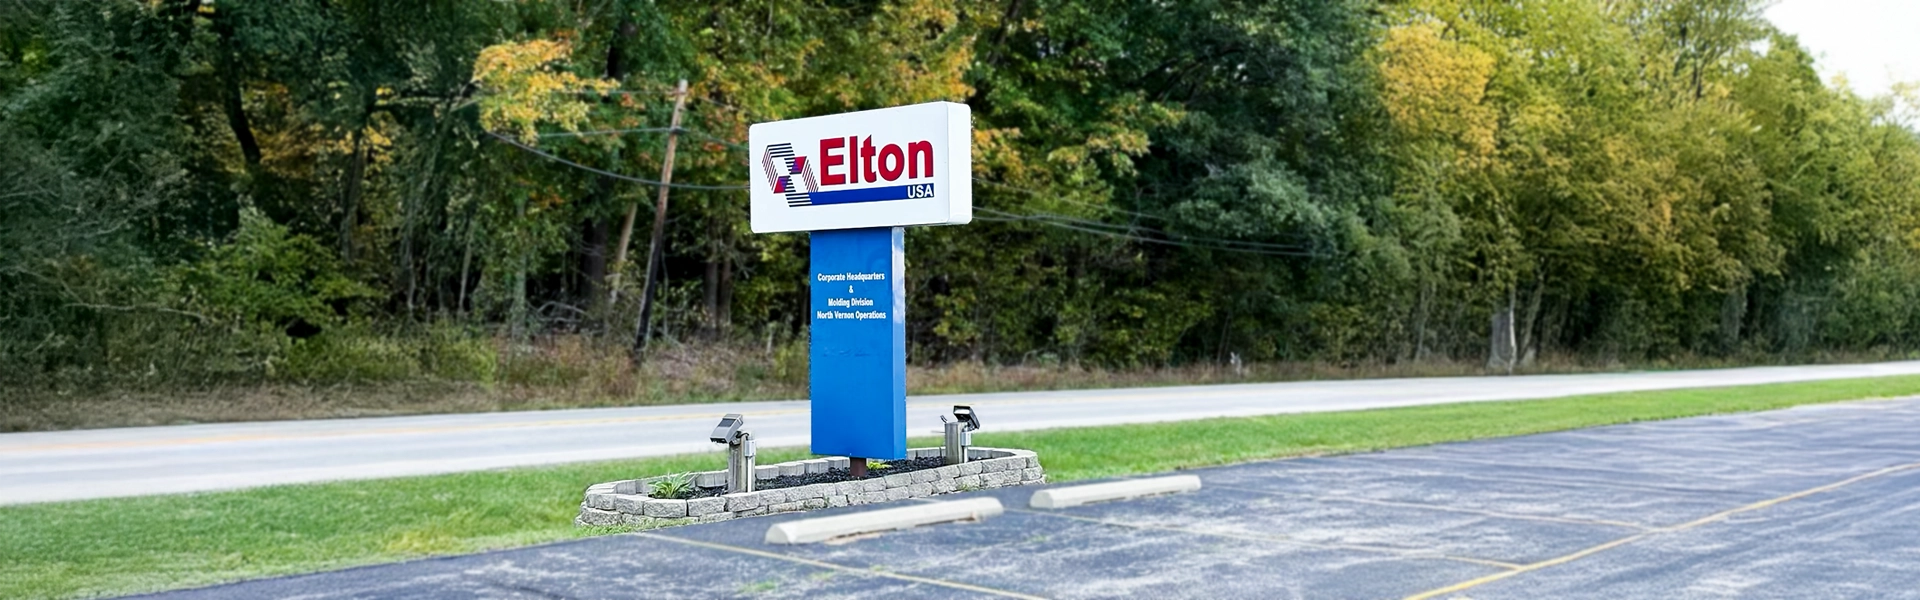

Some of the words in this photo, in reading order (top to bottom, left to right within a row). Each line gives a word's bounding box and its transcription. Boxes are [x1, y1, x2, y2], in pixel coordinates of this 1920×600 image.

[820, 134, 934, 186] Elton
[907, 185, 933, 198] USA
[818, 273, 846, 282] Corporate
[846, 272, 885, 282] Headquarters
[849, 285, 854, 293] &
[828, 298, 850, 308] Molding
[851, 298, 873, 306] Division
[817, 311, 833, 319] North
[834, 311, 854, 319] Vernon
[855, 311, 886, 320] Operations
